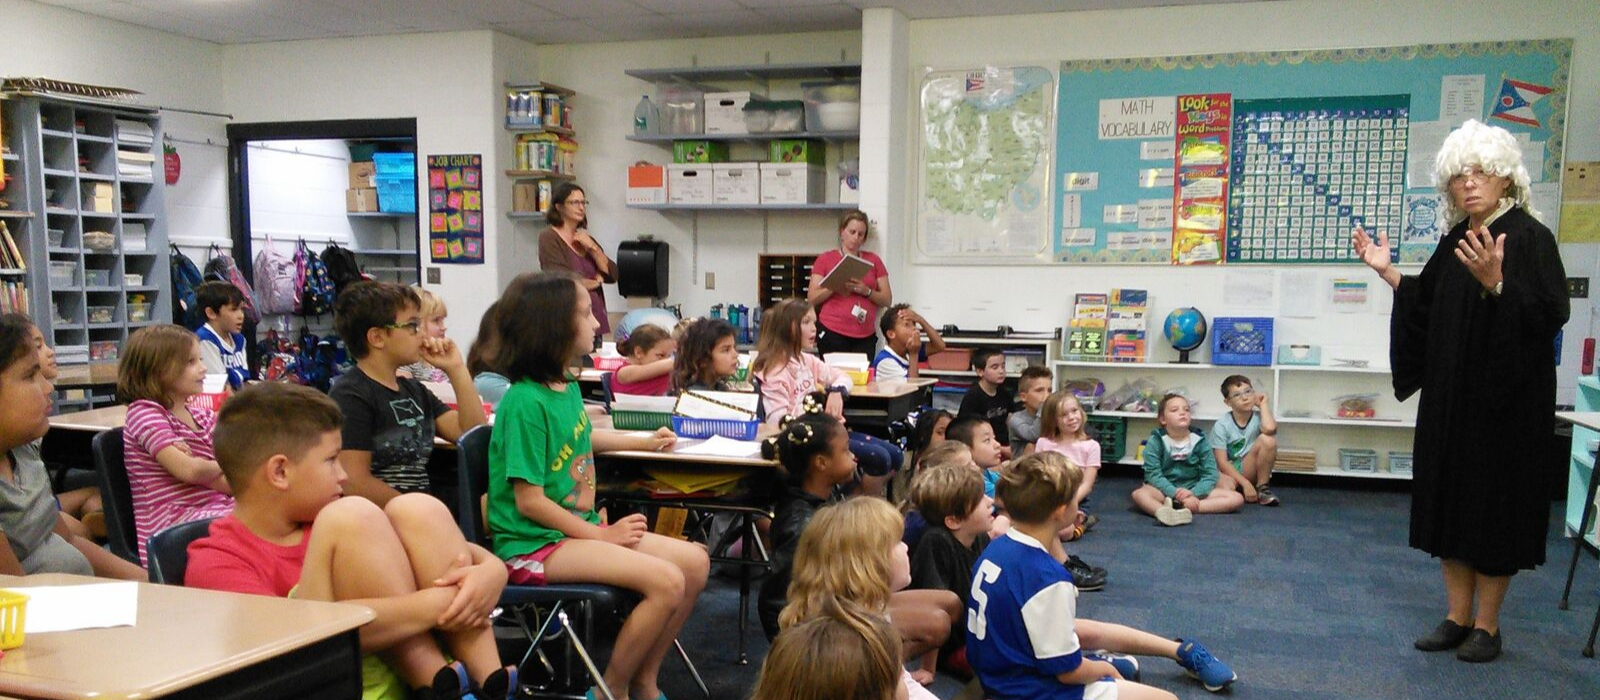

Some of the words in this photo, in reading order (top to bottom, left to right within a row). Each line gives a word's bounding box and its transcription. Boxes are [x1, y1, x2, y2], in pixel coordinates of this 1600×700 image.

[1121, 100, 1154, 115] MATH
[1180, 96, 1210, 112] Look
[1101, 121, 1172, 137] VOCABULARY
[435, 156, 448, 166] JOB
[450, 156, 473, 166] CHART
[1072, 177, 1090, 185] digit
[551, 443, 573, 472] OH
[967, 558, 1002, 640] 5
